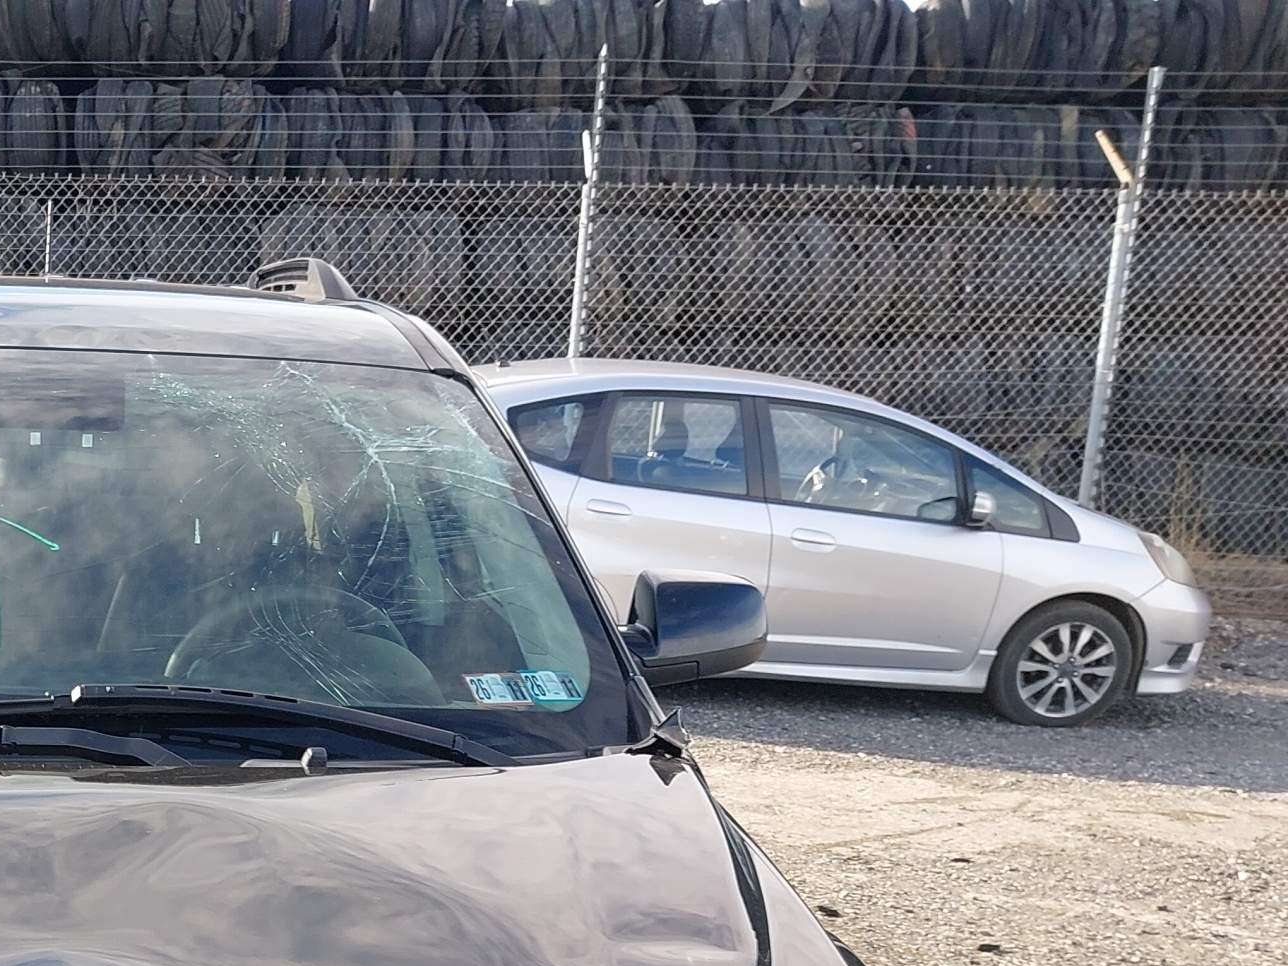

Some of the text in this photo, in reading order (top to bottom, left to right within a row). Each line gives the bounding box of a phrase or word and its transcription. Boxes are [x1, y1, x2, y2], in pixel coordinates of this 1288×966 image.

[469, 678, 529, 701] 26 11
[524, 675, 582, 698] 26 11
